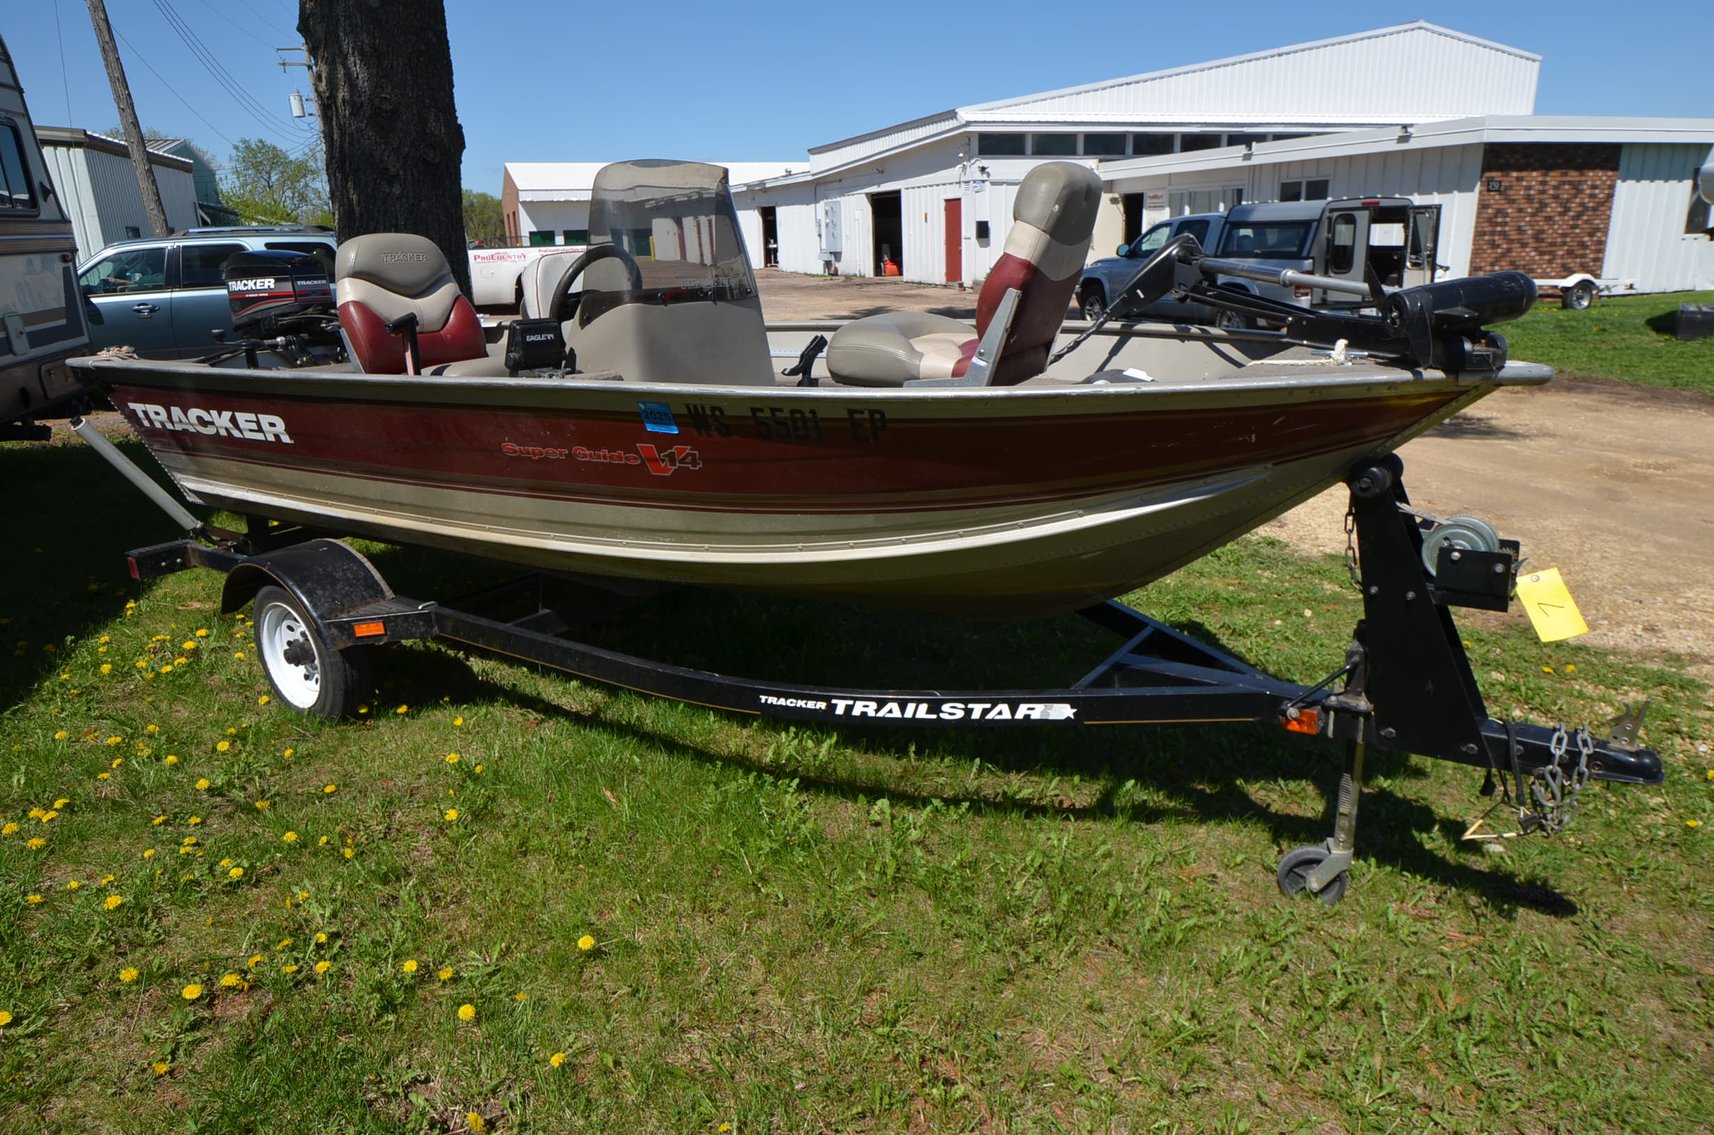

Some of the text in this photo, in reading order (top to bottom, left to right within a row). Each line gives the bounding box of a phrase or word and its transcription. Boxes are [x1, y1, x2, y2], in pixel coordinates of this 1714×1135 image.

[380, 251, 429, 262] TRACKER
[228, 278, 275, 291] TRACKER
[127, 402, 292, 444] TRACKER
[685, 403, 888, 443] WS 5501 EP
[501, 443, 568, 460] Super
[572, 446, 641, 464] Guide
[759, 695, 1046, 720] TRACKER TRAILSTAR
